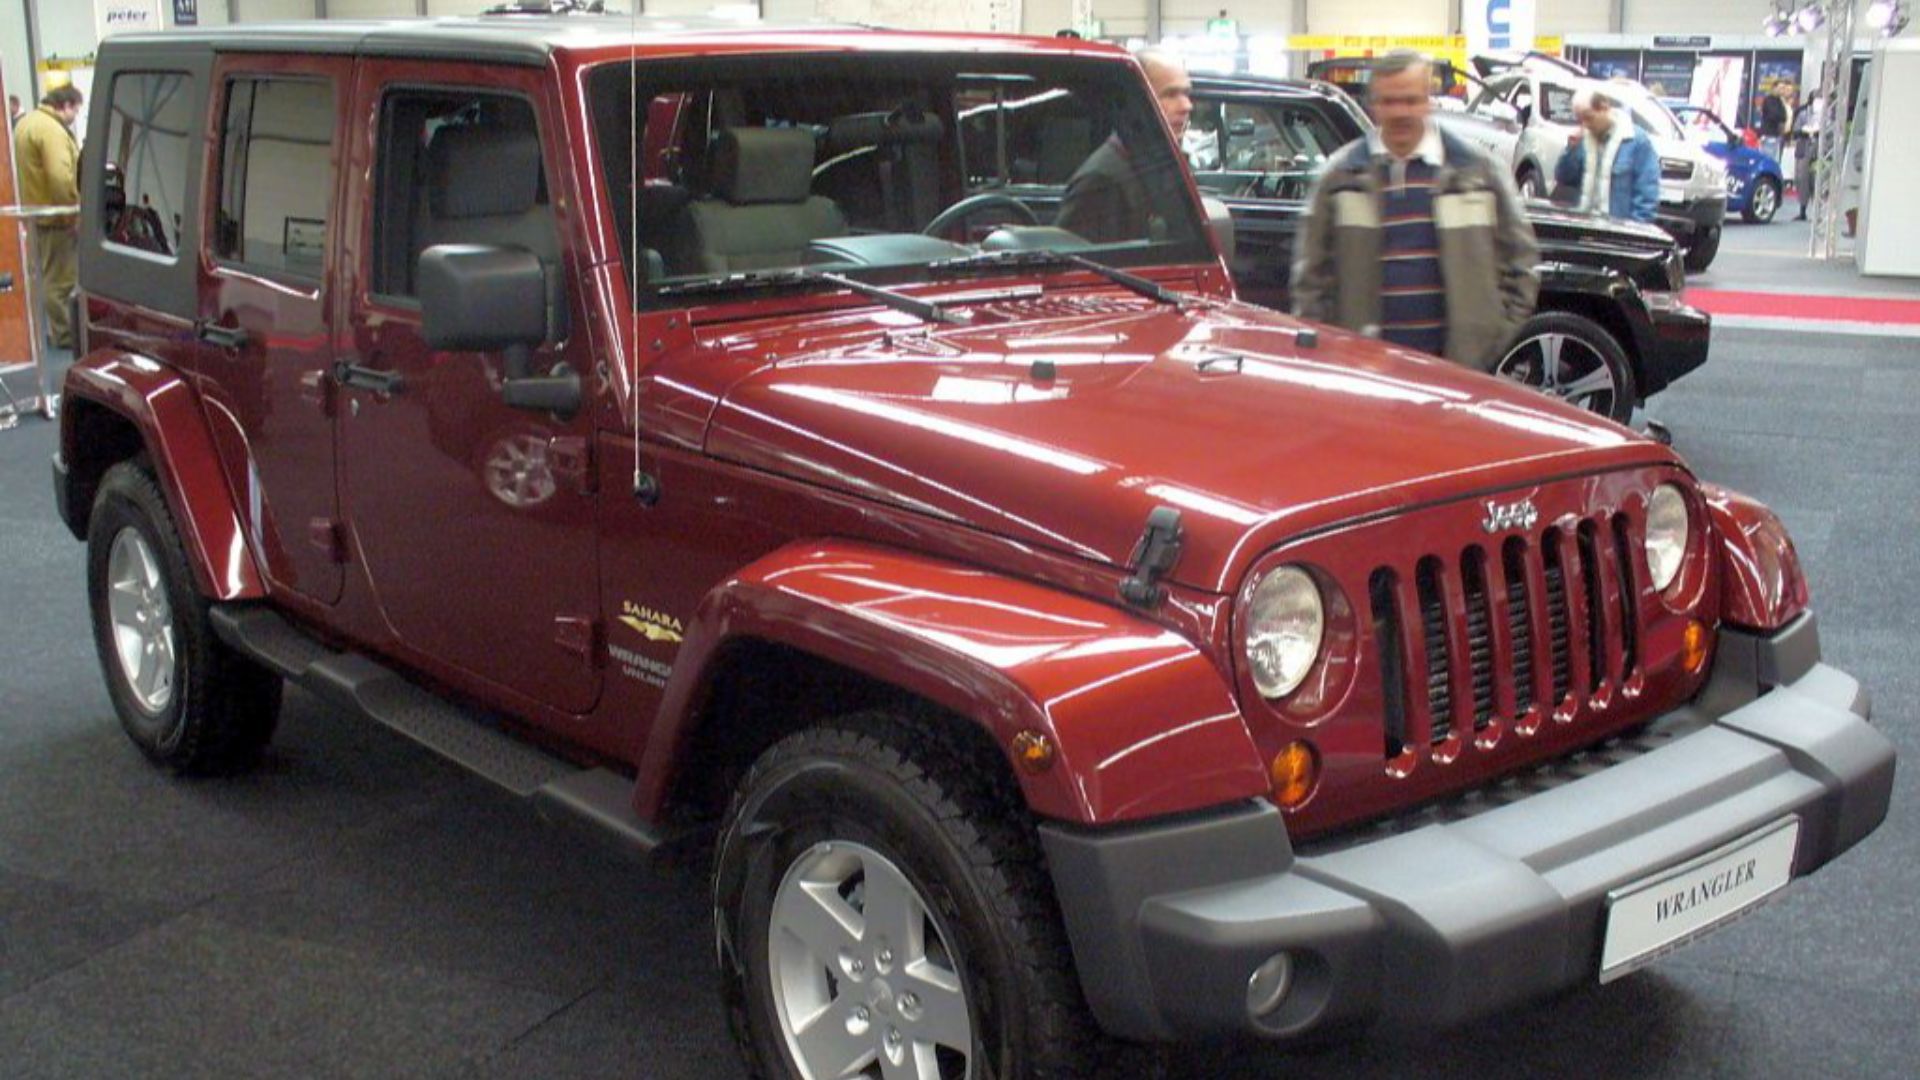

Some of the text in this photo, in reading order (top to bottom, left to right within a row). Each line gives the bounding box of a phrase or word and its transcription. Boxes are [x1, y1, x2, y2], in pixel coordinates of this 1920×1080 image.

[1482, 498, 1538, 533] Jeep
[623, 599, 682, 631] SAHARA
[1655, 858, 1757, 924] WRANGLER
